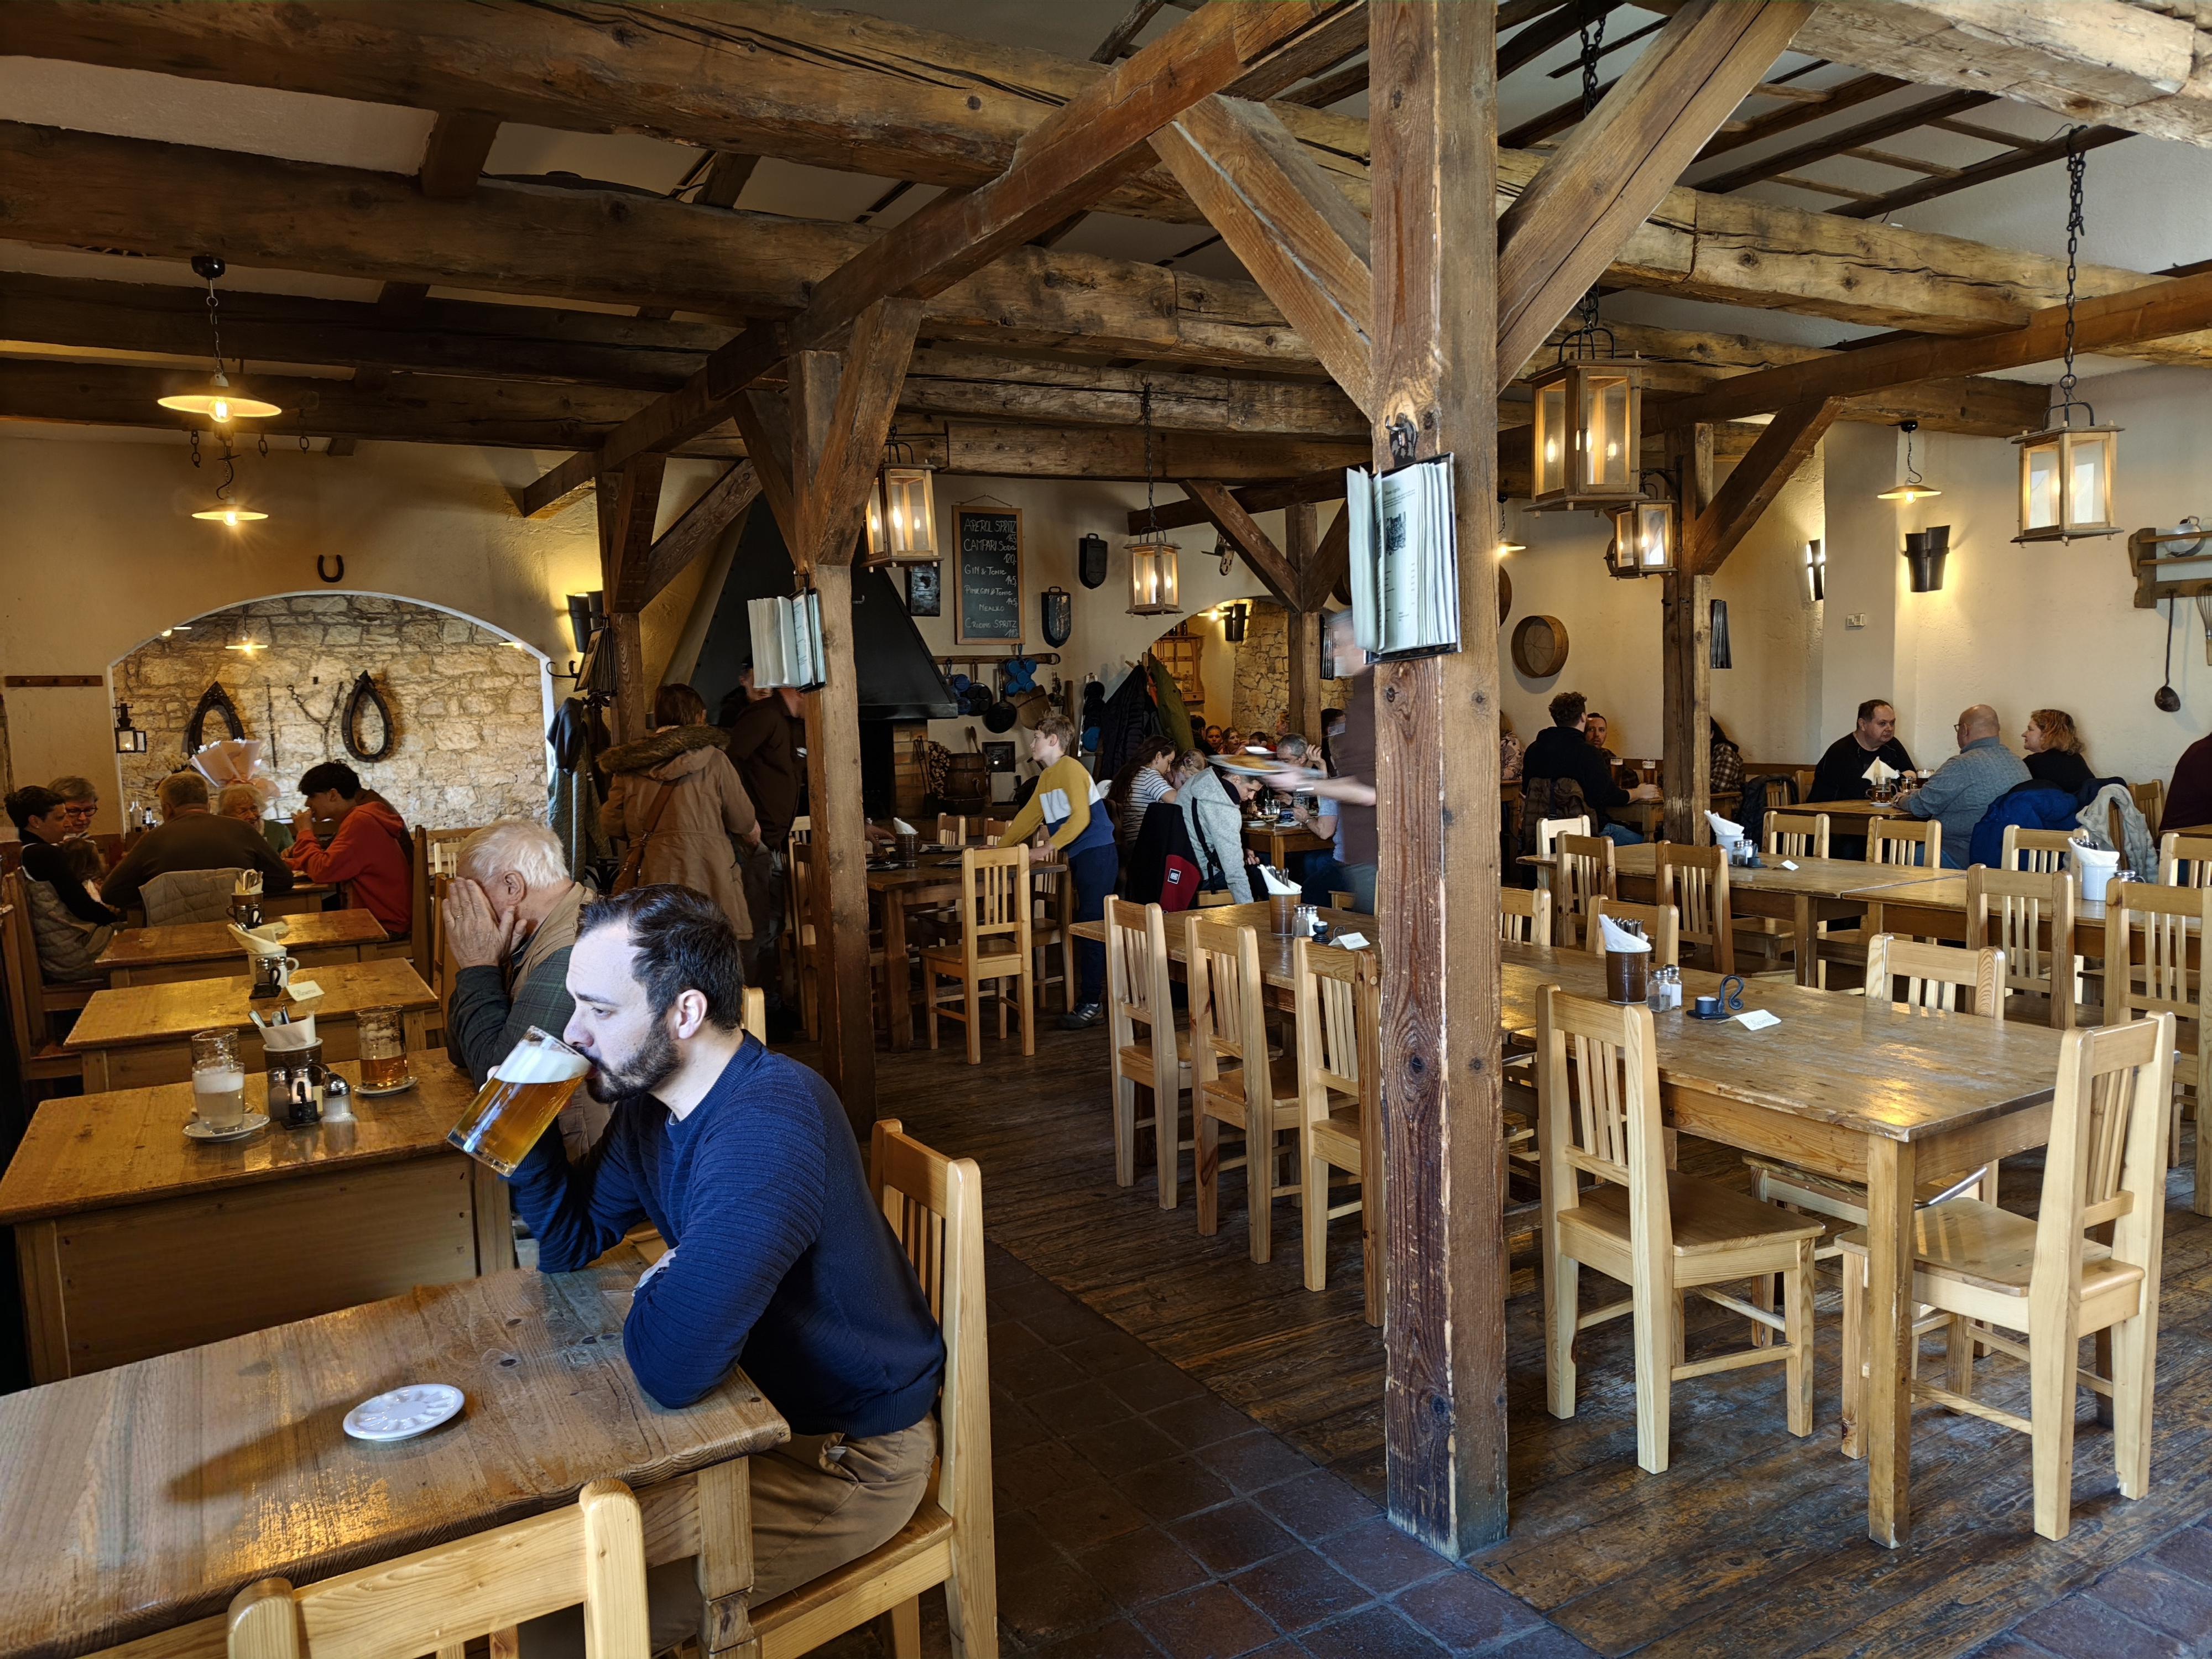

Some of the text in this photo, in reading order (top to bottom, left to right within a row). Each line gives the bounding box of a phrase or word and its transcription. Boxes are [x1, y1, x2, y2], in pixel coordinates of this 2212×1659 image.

[994, 520, 1017, 534] SPRITZ
[963, 538, 997, 552] CAMPARI
[964, 564, 979, 575] GIN
[993, 619, 1018, 628] SPRITZ
